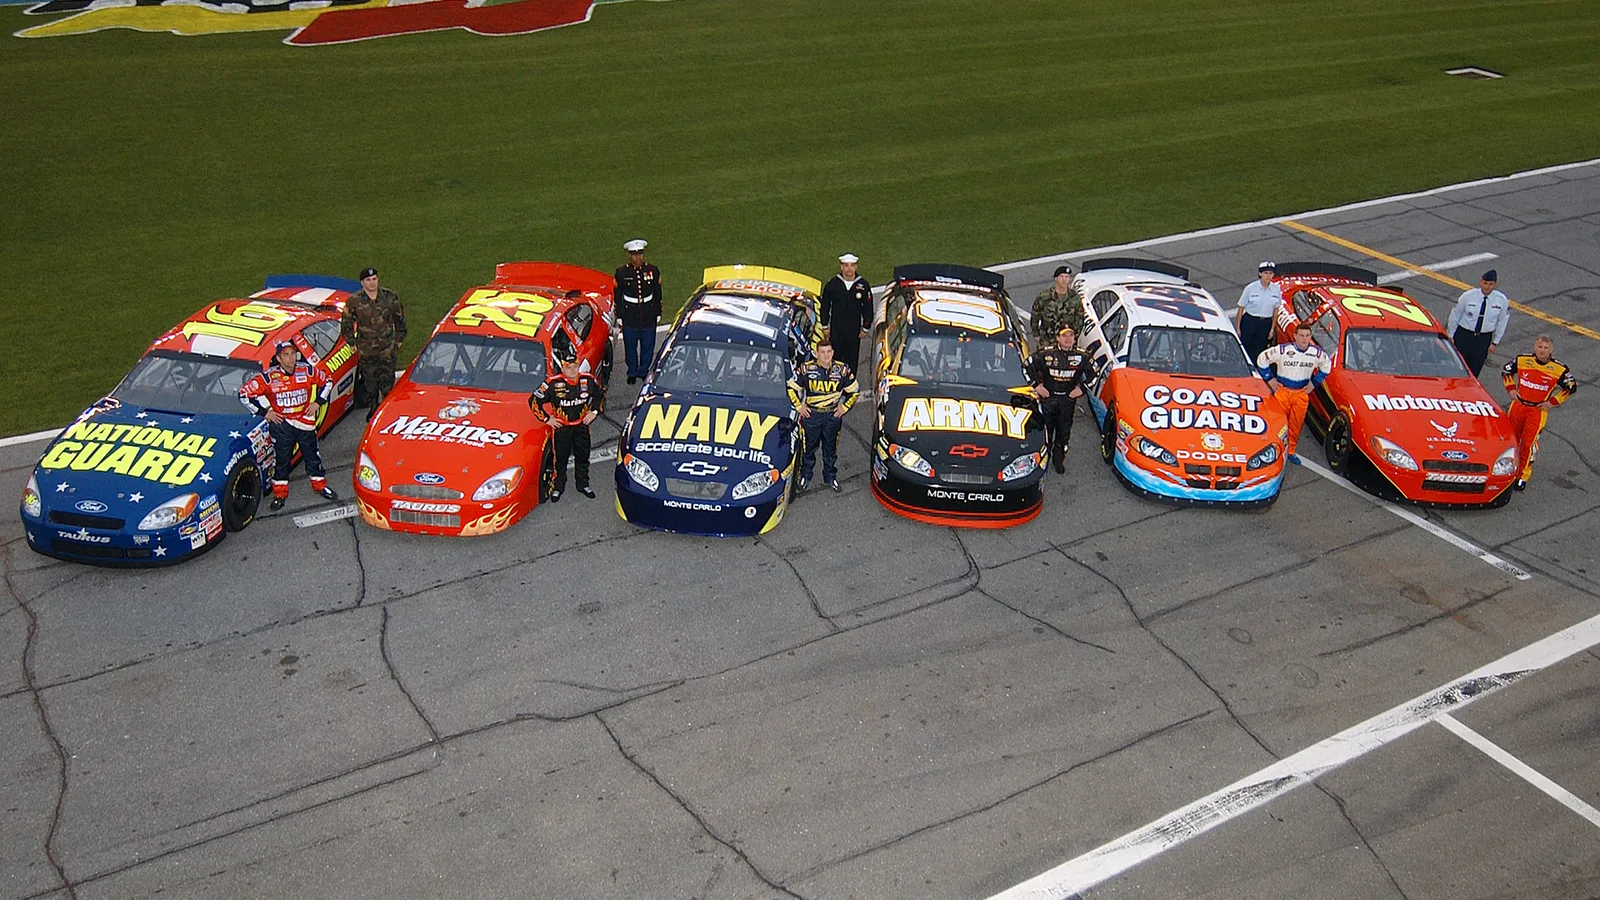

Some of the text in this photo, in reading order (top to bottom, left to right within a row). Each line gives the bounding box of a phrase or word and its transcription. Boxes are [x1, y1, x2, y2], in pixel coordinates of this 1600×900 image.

[454, 289, 554, 338] 25
[1329, 286, 1433, 327] 21
[183, 304, 295, 346] 16
[690, 294, 783, 340] 14
[808, 380, 840, 392] NAVY
[276, 394, 308, 407] GUARD
[1144, 384, 1262, 412] COAST
[1362, 394, 1500, 418] Motorcraft
[898, 397, 1032, 440] ARMY
[1140, 406, 1267, 435] GUARD
[380, 416, 518, 445] Marines
[640, 404, 780, 450] NAVY
[62, 422, 218, 458] NATIONAL
[636, 442, 712, 454] accelerate
[714, 446, 749, 460] your
[1176, 450, 1248, 462] DODGE
[41, 441, 206, 486] GUARD
[634, 464, 646, 478] 14
[360, 466, 374, 481] 25
[419, 474, 440, 483] Ford
[1426, 472, 1488, 484] TAURUS
[25, 494, 38, 506] 16
[928, 490, 1004, 502] MONTE CARLO
[80, 502, 101, 512] Ford
[391, 500, 462, 512] TAURUS
[664, 500, 722, 512] MONTE CARLO
[58, 530, 111, 544] TAURUS
